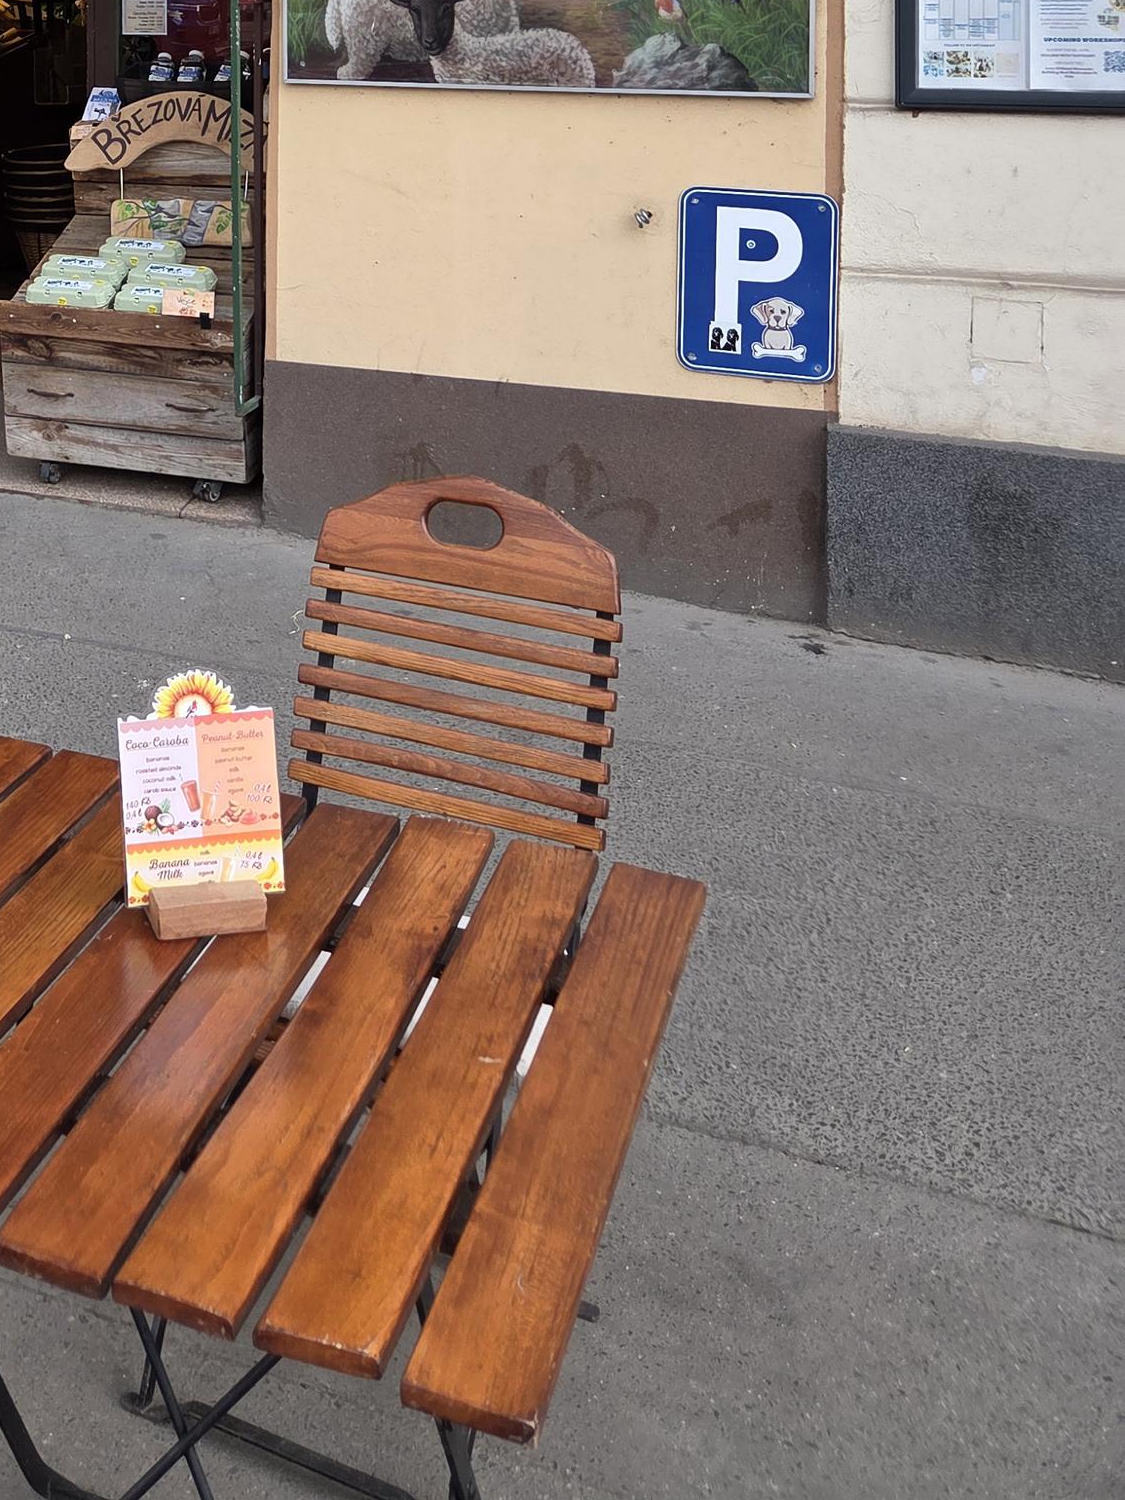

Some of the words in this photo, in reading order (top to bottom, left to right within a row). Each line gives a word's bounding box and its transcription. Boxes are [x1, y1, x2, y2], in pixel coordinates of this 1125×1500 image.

[91, 95, 207, 165] BŘEZOVÁ
[715, 206, 803, 323] P
[149, 859, 190, 870] Banana
[157, 870, 184, 881] Milk
